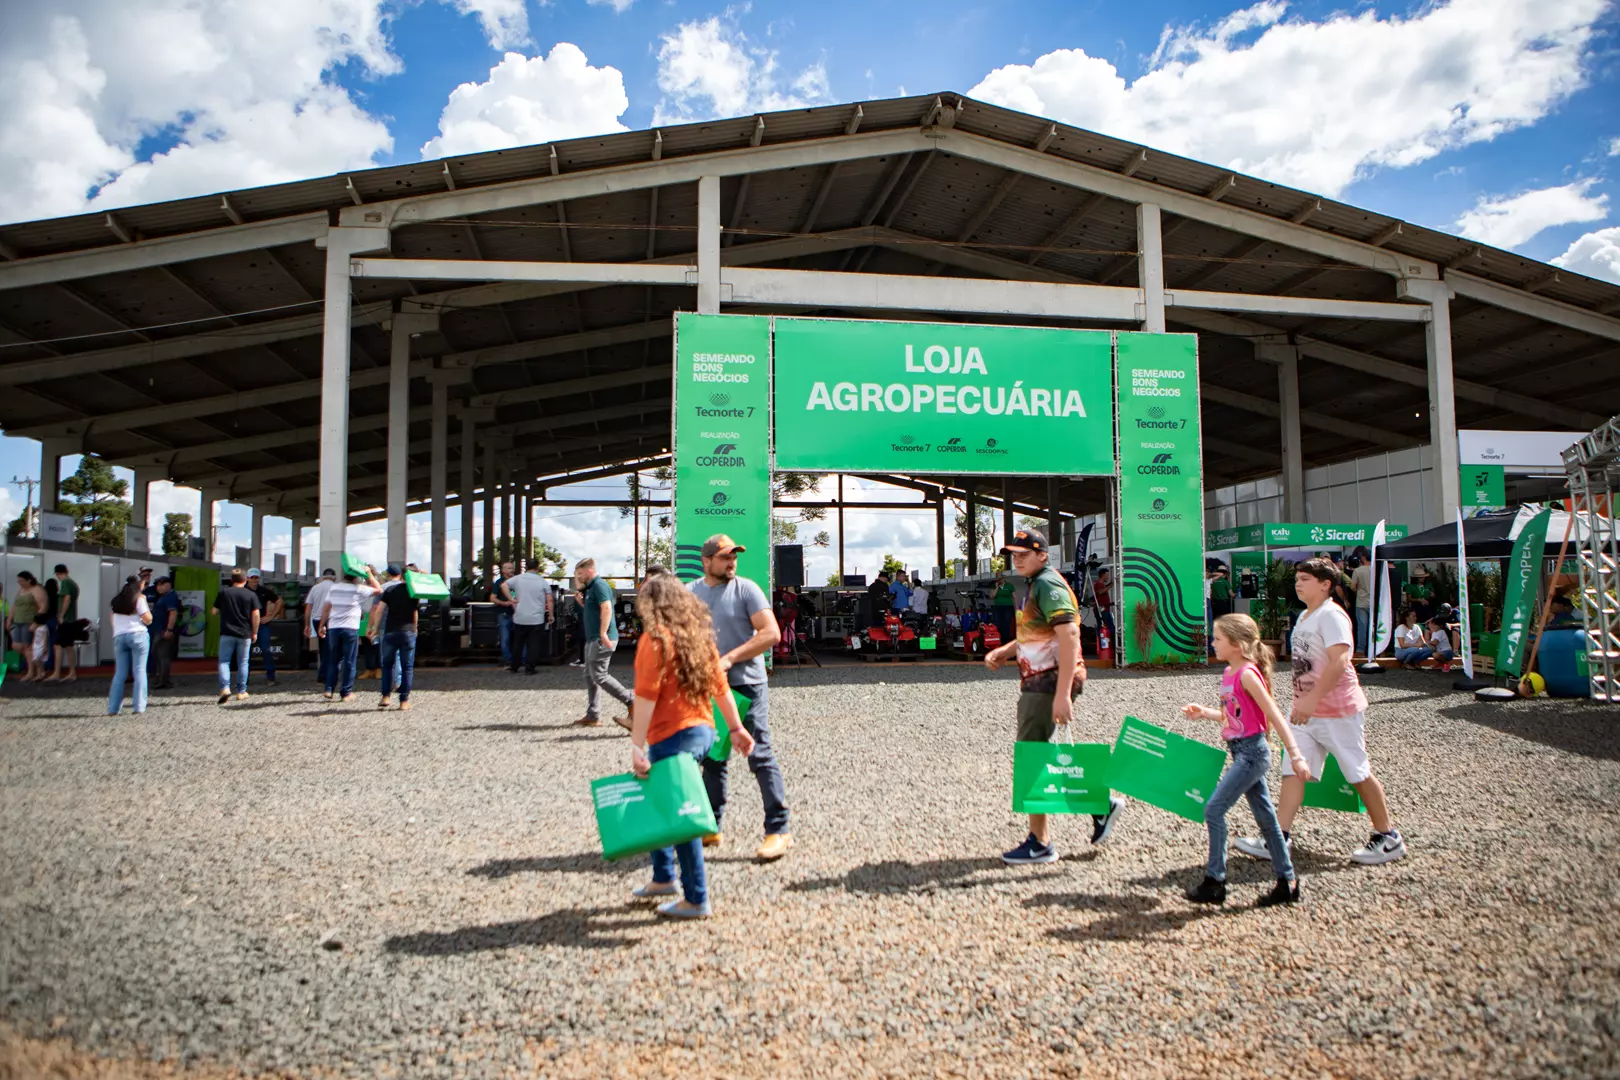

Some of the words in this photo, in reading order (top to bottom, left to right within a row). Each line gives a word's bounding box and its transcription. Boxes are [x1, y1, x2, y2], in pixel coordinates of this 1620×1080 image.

[692, 353, 756, 364] SEMEANDO
[905, 345, 988, 375] LOJA
[693, 363, 724, 373] BONS
[692, 372, 750, 383] NEGÓCIOS
[1131, 369, 1185, 379] SEMEANDO
[1132, 378, 1158, 387] BONS
[1132, 386, 1181, 397] NEGÓCIOS
[806, 381, 1087, 418] AGROPECUÁRIA
[695, 406, 745, 418] Tecnorte
[746, 406, 756, 418] 7
[1135, 418, 1179, 429] Tecnorte
[1179, 418, 1188, 429] 7
[891, 443, 924, 453] Tecnorte
[925, 443, 932, 453] 7
[1500, 453, 1505, 461] 7
[708, 479, 731, 487] APOIO:
[694, 508, 747, 516] SESCOOP/SC
[1216, 532, 1239, 546] Sicredi
[1326, 529, 1365, 541] Sicredi
